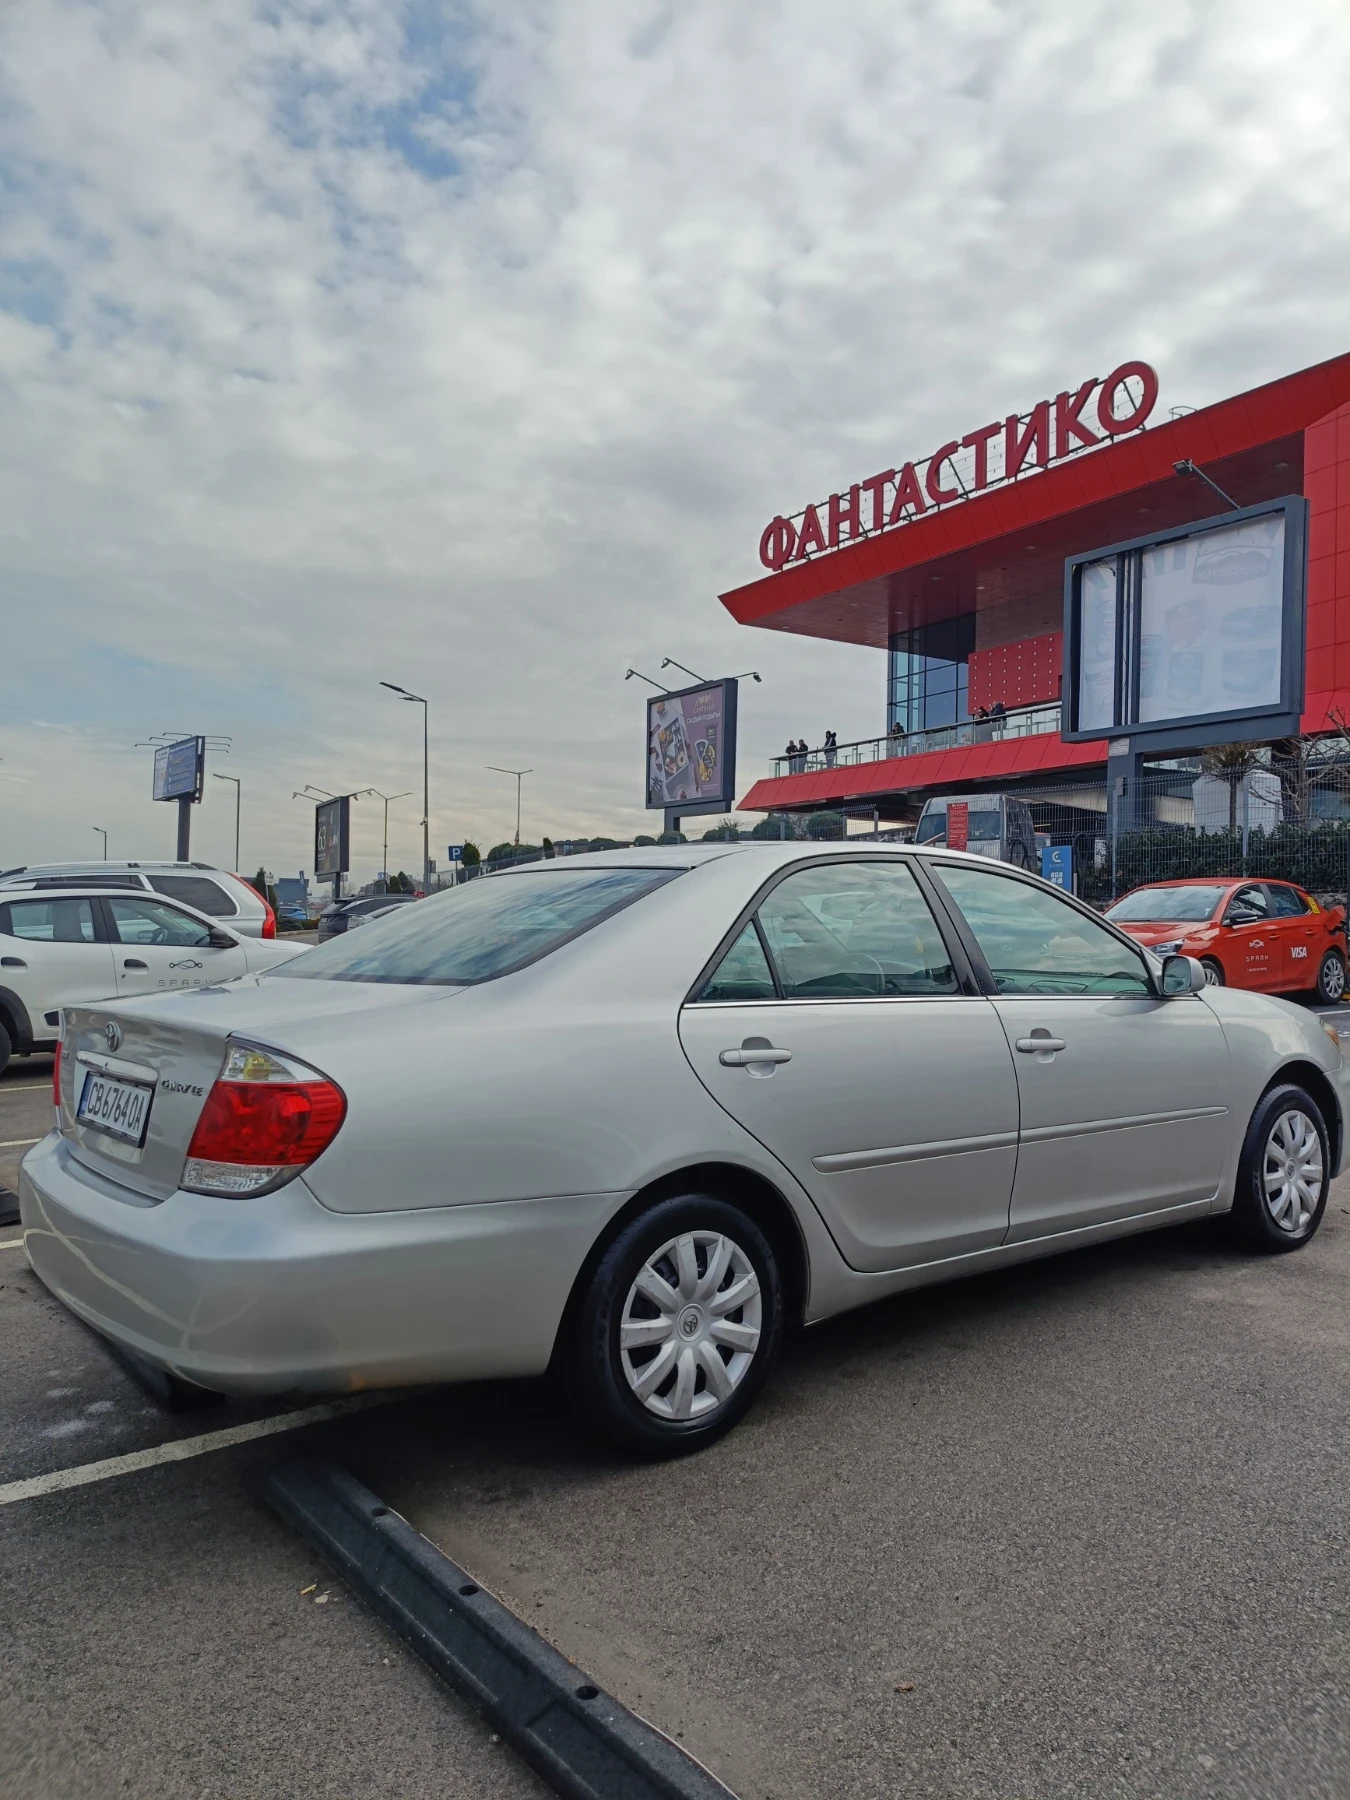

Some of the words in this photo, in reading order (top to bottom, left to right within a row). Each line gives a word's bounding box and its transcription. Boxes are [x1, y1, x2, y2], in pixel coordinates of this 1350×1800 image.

[759, 360, 1158, 571] ФАНТАСТИКО
[452, 847, 461, 859] P
[1245, 954, 1269, 962] SPARK
[1290, 946, 1307, 958] VISA
